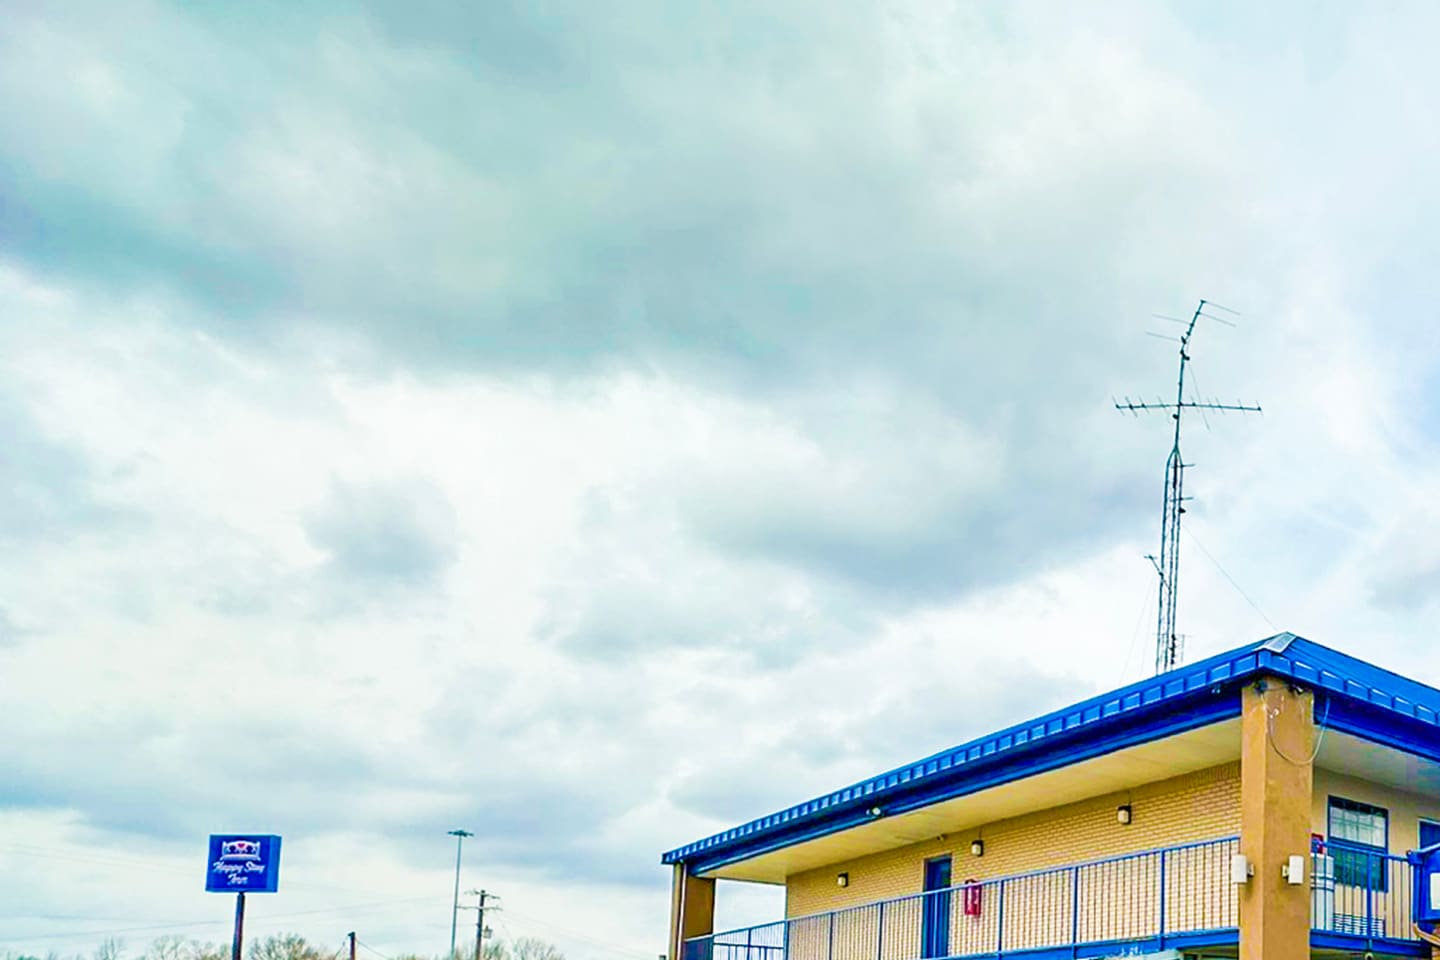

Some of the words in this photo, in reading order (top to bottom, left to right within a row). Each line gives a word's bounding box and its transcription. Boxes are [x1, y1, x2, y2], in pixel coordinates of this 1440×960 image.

[213, 861, 243, 874] Happy
[244, 861, 265, 874] Stay
[227, 873, 248, 886] Inn
